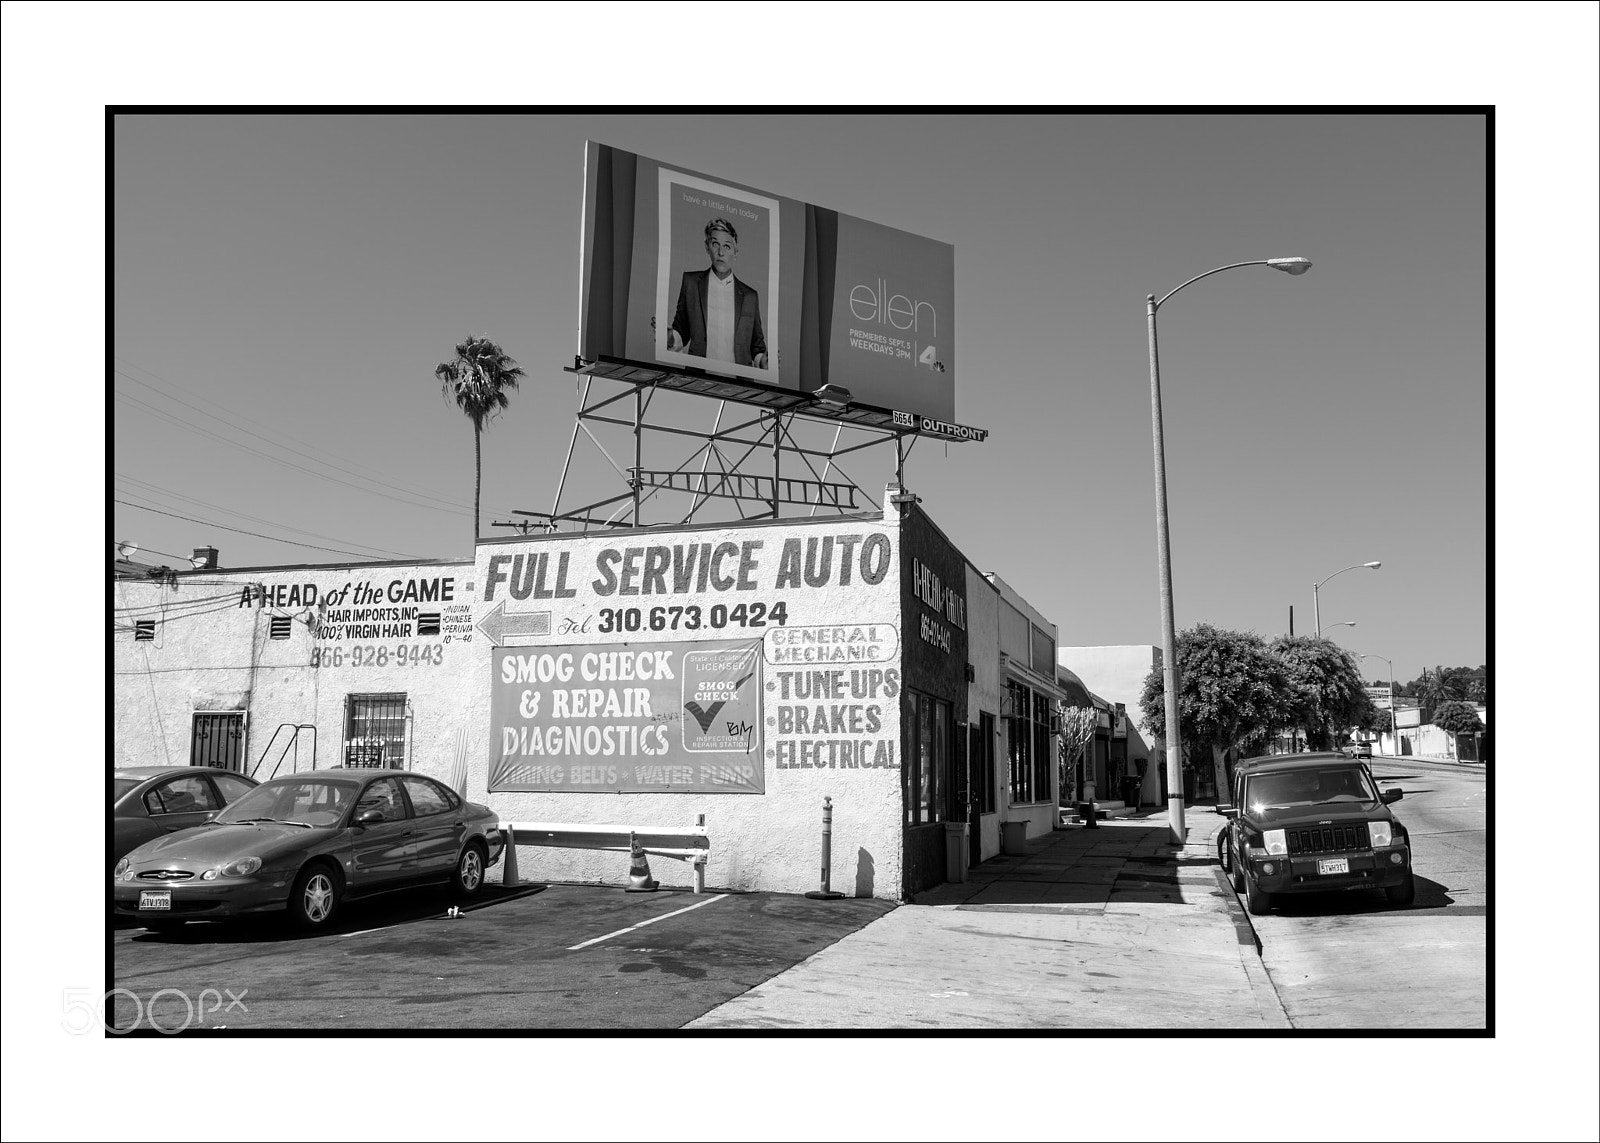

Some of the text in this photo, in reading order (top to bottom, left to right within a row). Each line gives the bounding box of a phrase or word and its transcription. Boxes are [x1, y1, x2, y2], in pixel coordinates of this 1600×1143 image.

[683, 193, 701, 205] have
[708, 200, 725, 211] little
[726, 205, 738, 215] fun
[739, 209, 759, 221] today
[850, 277, 937, 338] ellen
[849, 328, 887, 344] PREMIERES
[888, 337, 906, 349] SEPT.
[849, 337, 911, 360] WEEKDAYS 3PM
[919, 345, 937, 371] 4
[894, 412, 912, 426] 6654
[922, 418, 983, 441] OUTFRONT
[484, 532, 892, 602] FULL SERVICE AUTO
[325, 582, 351, 606] of
[353, 580, 383, 605] the
[387, 577, 455, 603] GAME
[327, 609, 351, 622] HAIR
[445, 615, 472, 623] CHINESE
[598, 602, 788, 633] 310.673.0424
[316, 623, 412, 641] 100% VIRGIN HAIR
[772, 627, 884, 645] GENERAL
[309, 643, 444, 668] 866-928-9443
[718, 654, 753, 662] Califor
[774, 645, 881, 662] MECHANIC
[501, 650, 675, 683] SMOG CHECK
[696, 662, 746, 671] LICENSED
[698, 681, 736, 691] SMOG
[776, 668, 900, 700] TUNE-UPS
[519, 690, 541, 718] &
[552, 687, 653, 719] REPAIR
[694, 691, 739, 701] CHECK
[777, 704, 882, 735] BRAKES
[502, 724, 670, 757] DIAGNOSTICS
[719, 741, 749, 749] STATION
[775, 740, 901, 770] ELECTRICAL
[570, 765, 617, 784] BELTS
[634, 765, 694, 784] WATER
[700, 764, 754, 784] PUMP
